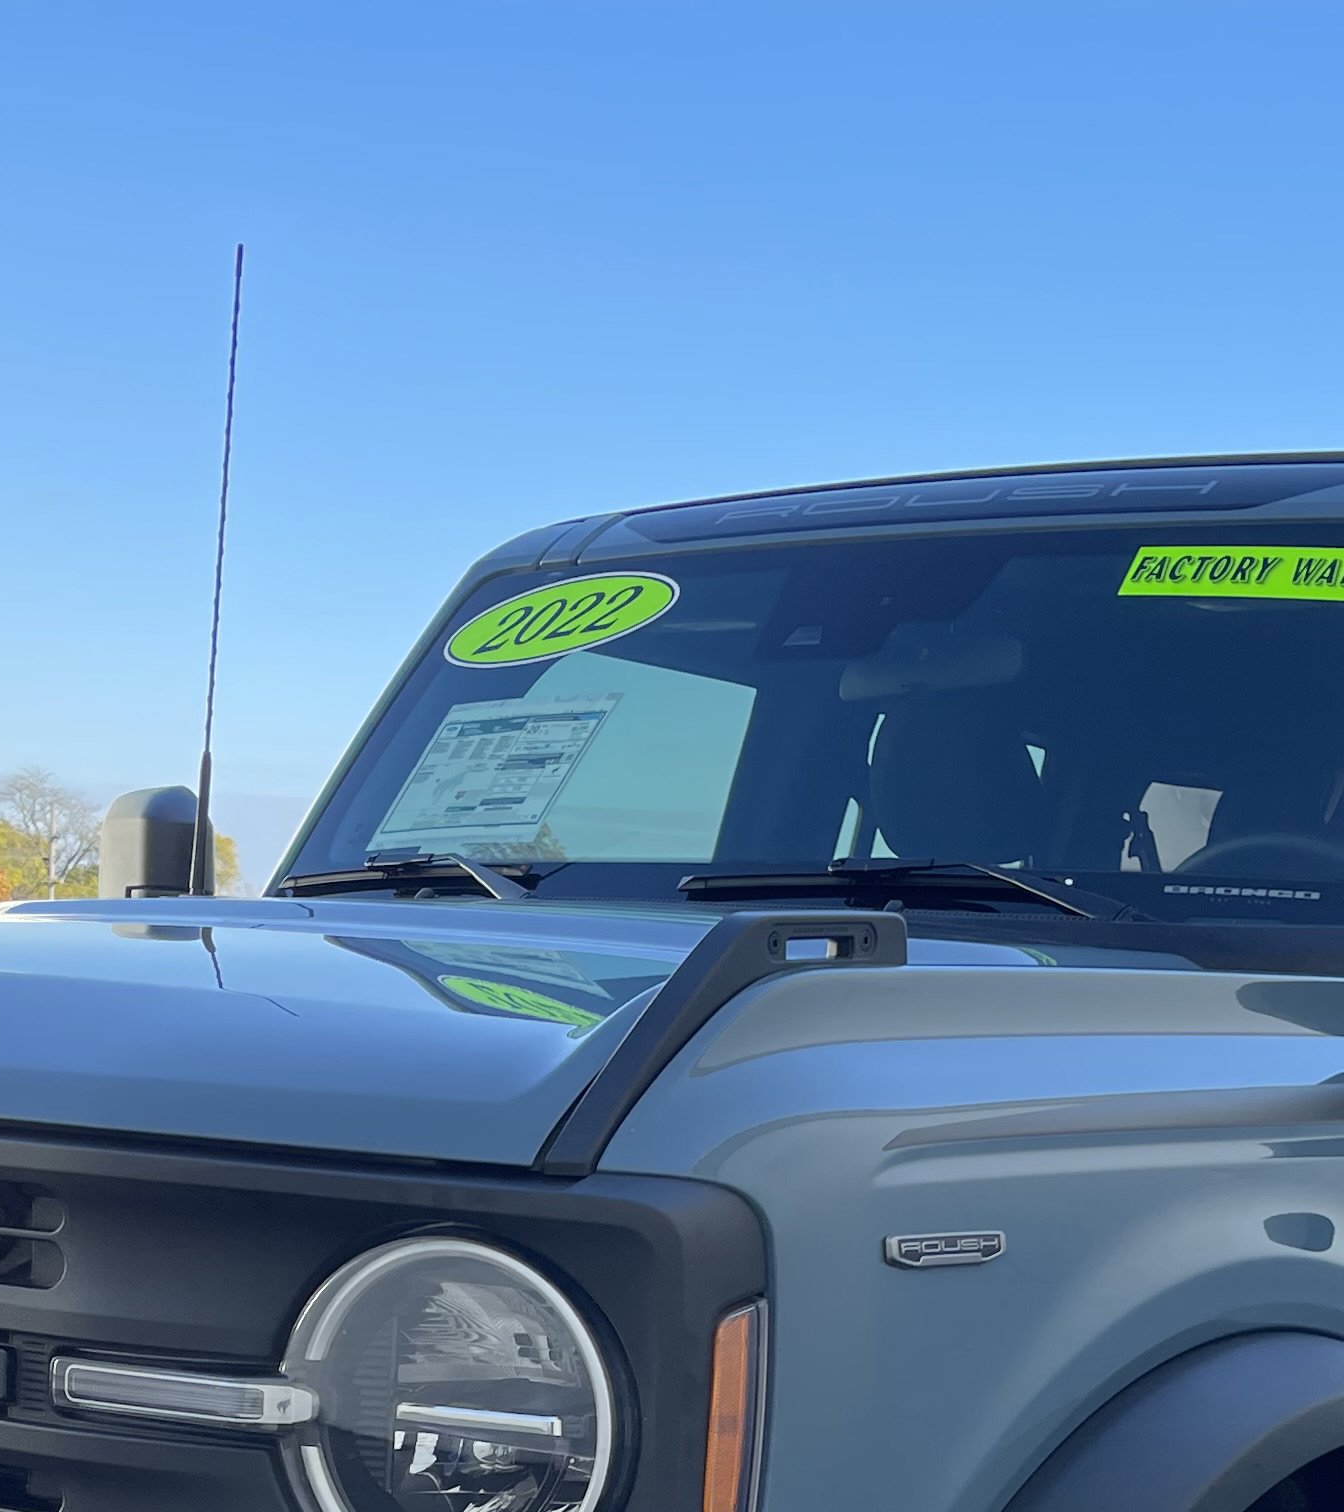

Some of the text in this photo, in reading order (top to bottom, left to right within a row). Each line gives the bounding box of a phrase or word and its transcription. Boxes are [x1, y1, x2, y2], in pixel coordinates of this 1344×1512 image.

[714, 480, 1219, 525] ROUSH
[1130, 555, 1281, 584] FACTORY
[471, 585, 644, 656] 2022
[1163, 885, 1321, 900] BRONCO
[901, 1238, 999, 1254] ROUSH
